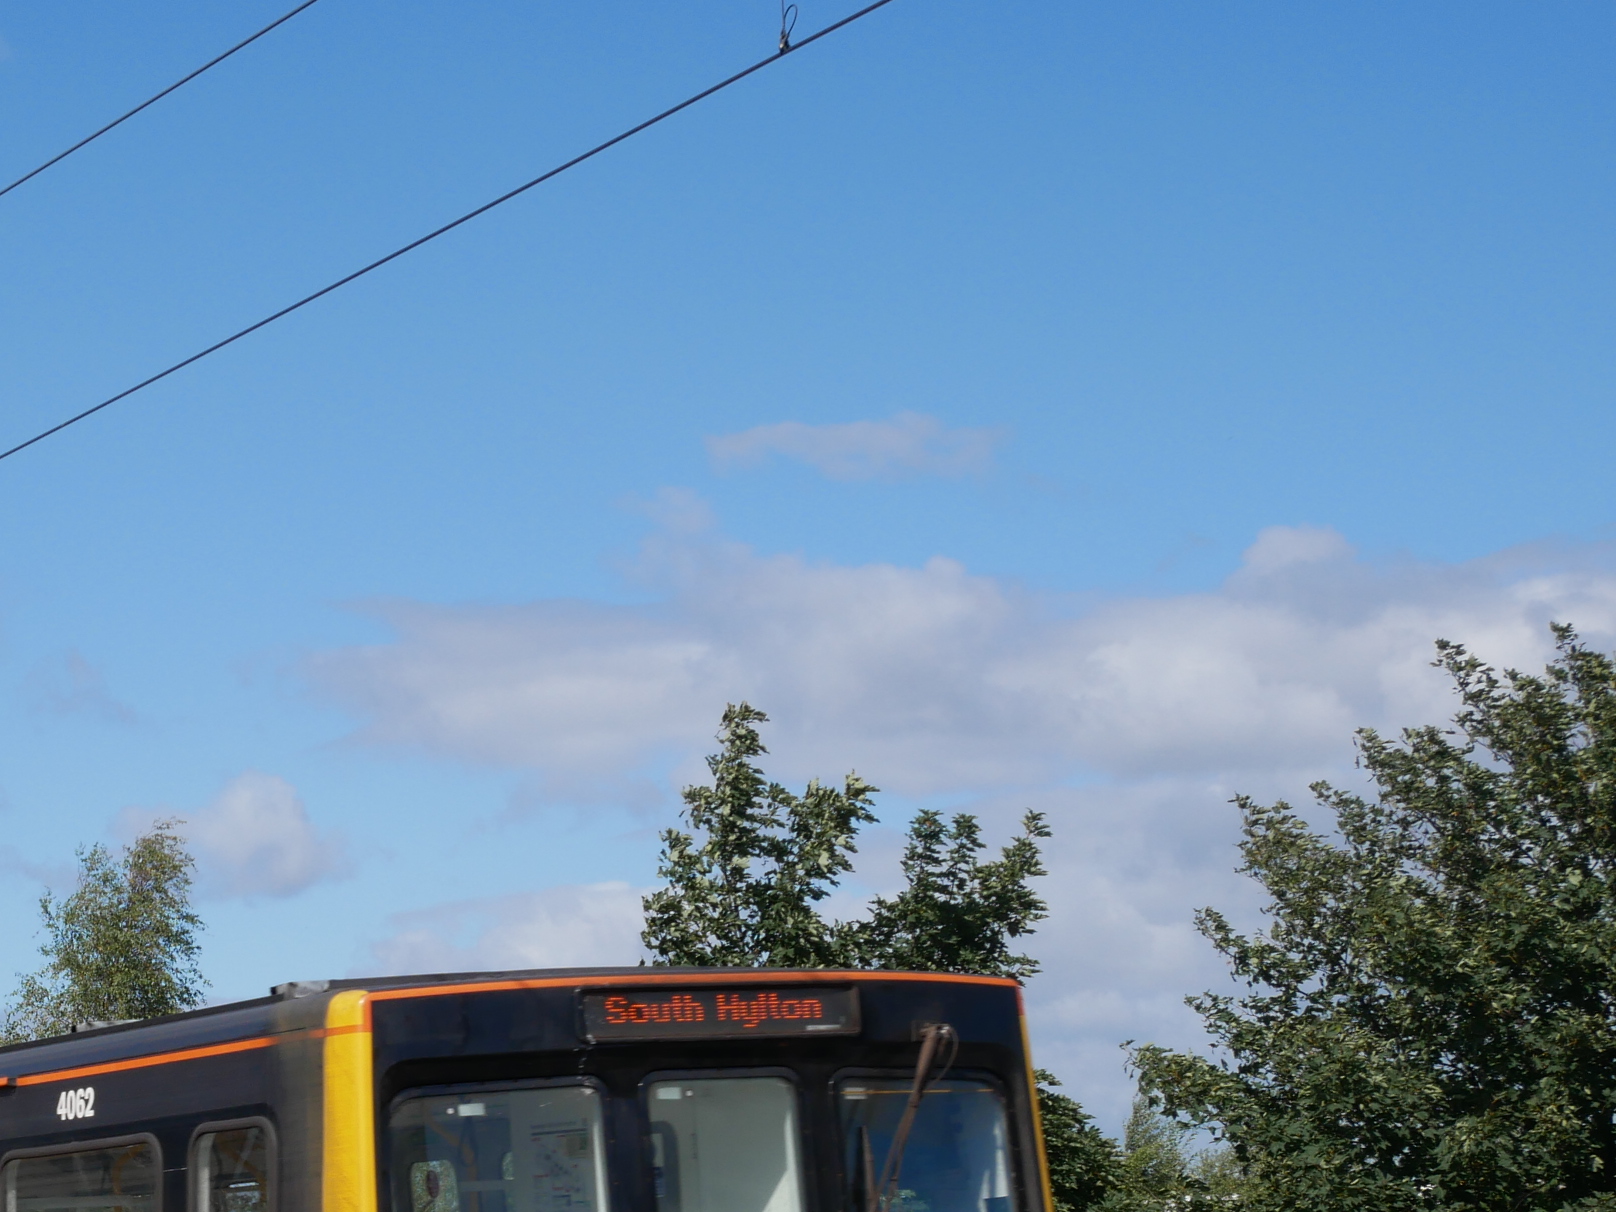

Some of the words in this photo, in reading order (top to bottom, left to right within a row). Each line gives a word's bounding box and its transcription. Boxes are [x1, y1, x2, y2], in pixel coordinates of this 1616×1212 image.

[605, 995, 705, 1023] South
[716, 993, 823, 1028] Hylton
[56, 1087, 95, 1121] 4062
